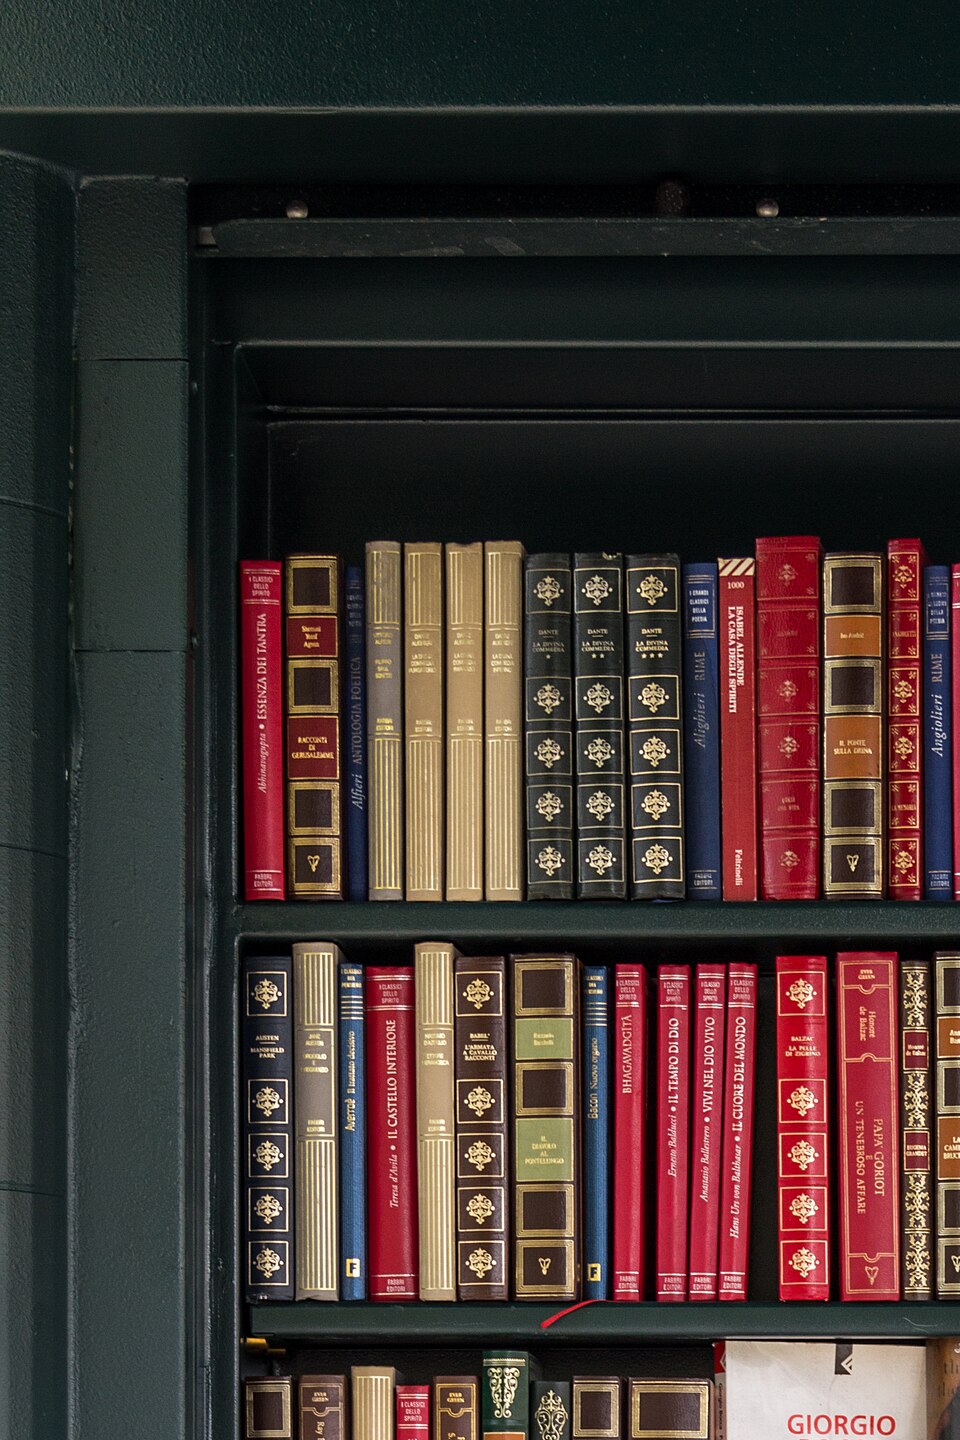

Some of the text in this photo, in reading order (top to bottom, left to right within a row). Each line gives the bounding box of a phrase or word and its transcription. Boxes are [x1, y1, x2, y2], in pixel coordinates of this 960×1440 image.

[728, 607, 735, 618] LA
[257, 614, 266, 654] TANTRA
[257, 658, 266, 674] DEI
[257, 677, 267, 719] ESSENZA
[931, 654, 945, 757] Angiolieri RIME
[735, 849, 743, 885] Feltrinelli
[386, 1020, 398, 1139] IL CASTELLO INTERIORE
[732, 1017, 745, 1131] IL CUORE DEL MONDO
[788, 1415, 895, 1435] GIORGIO
